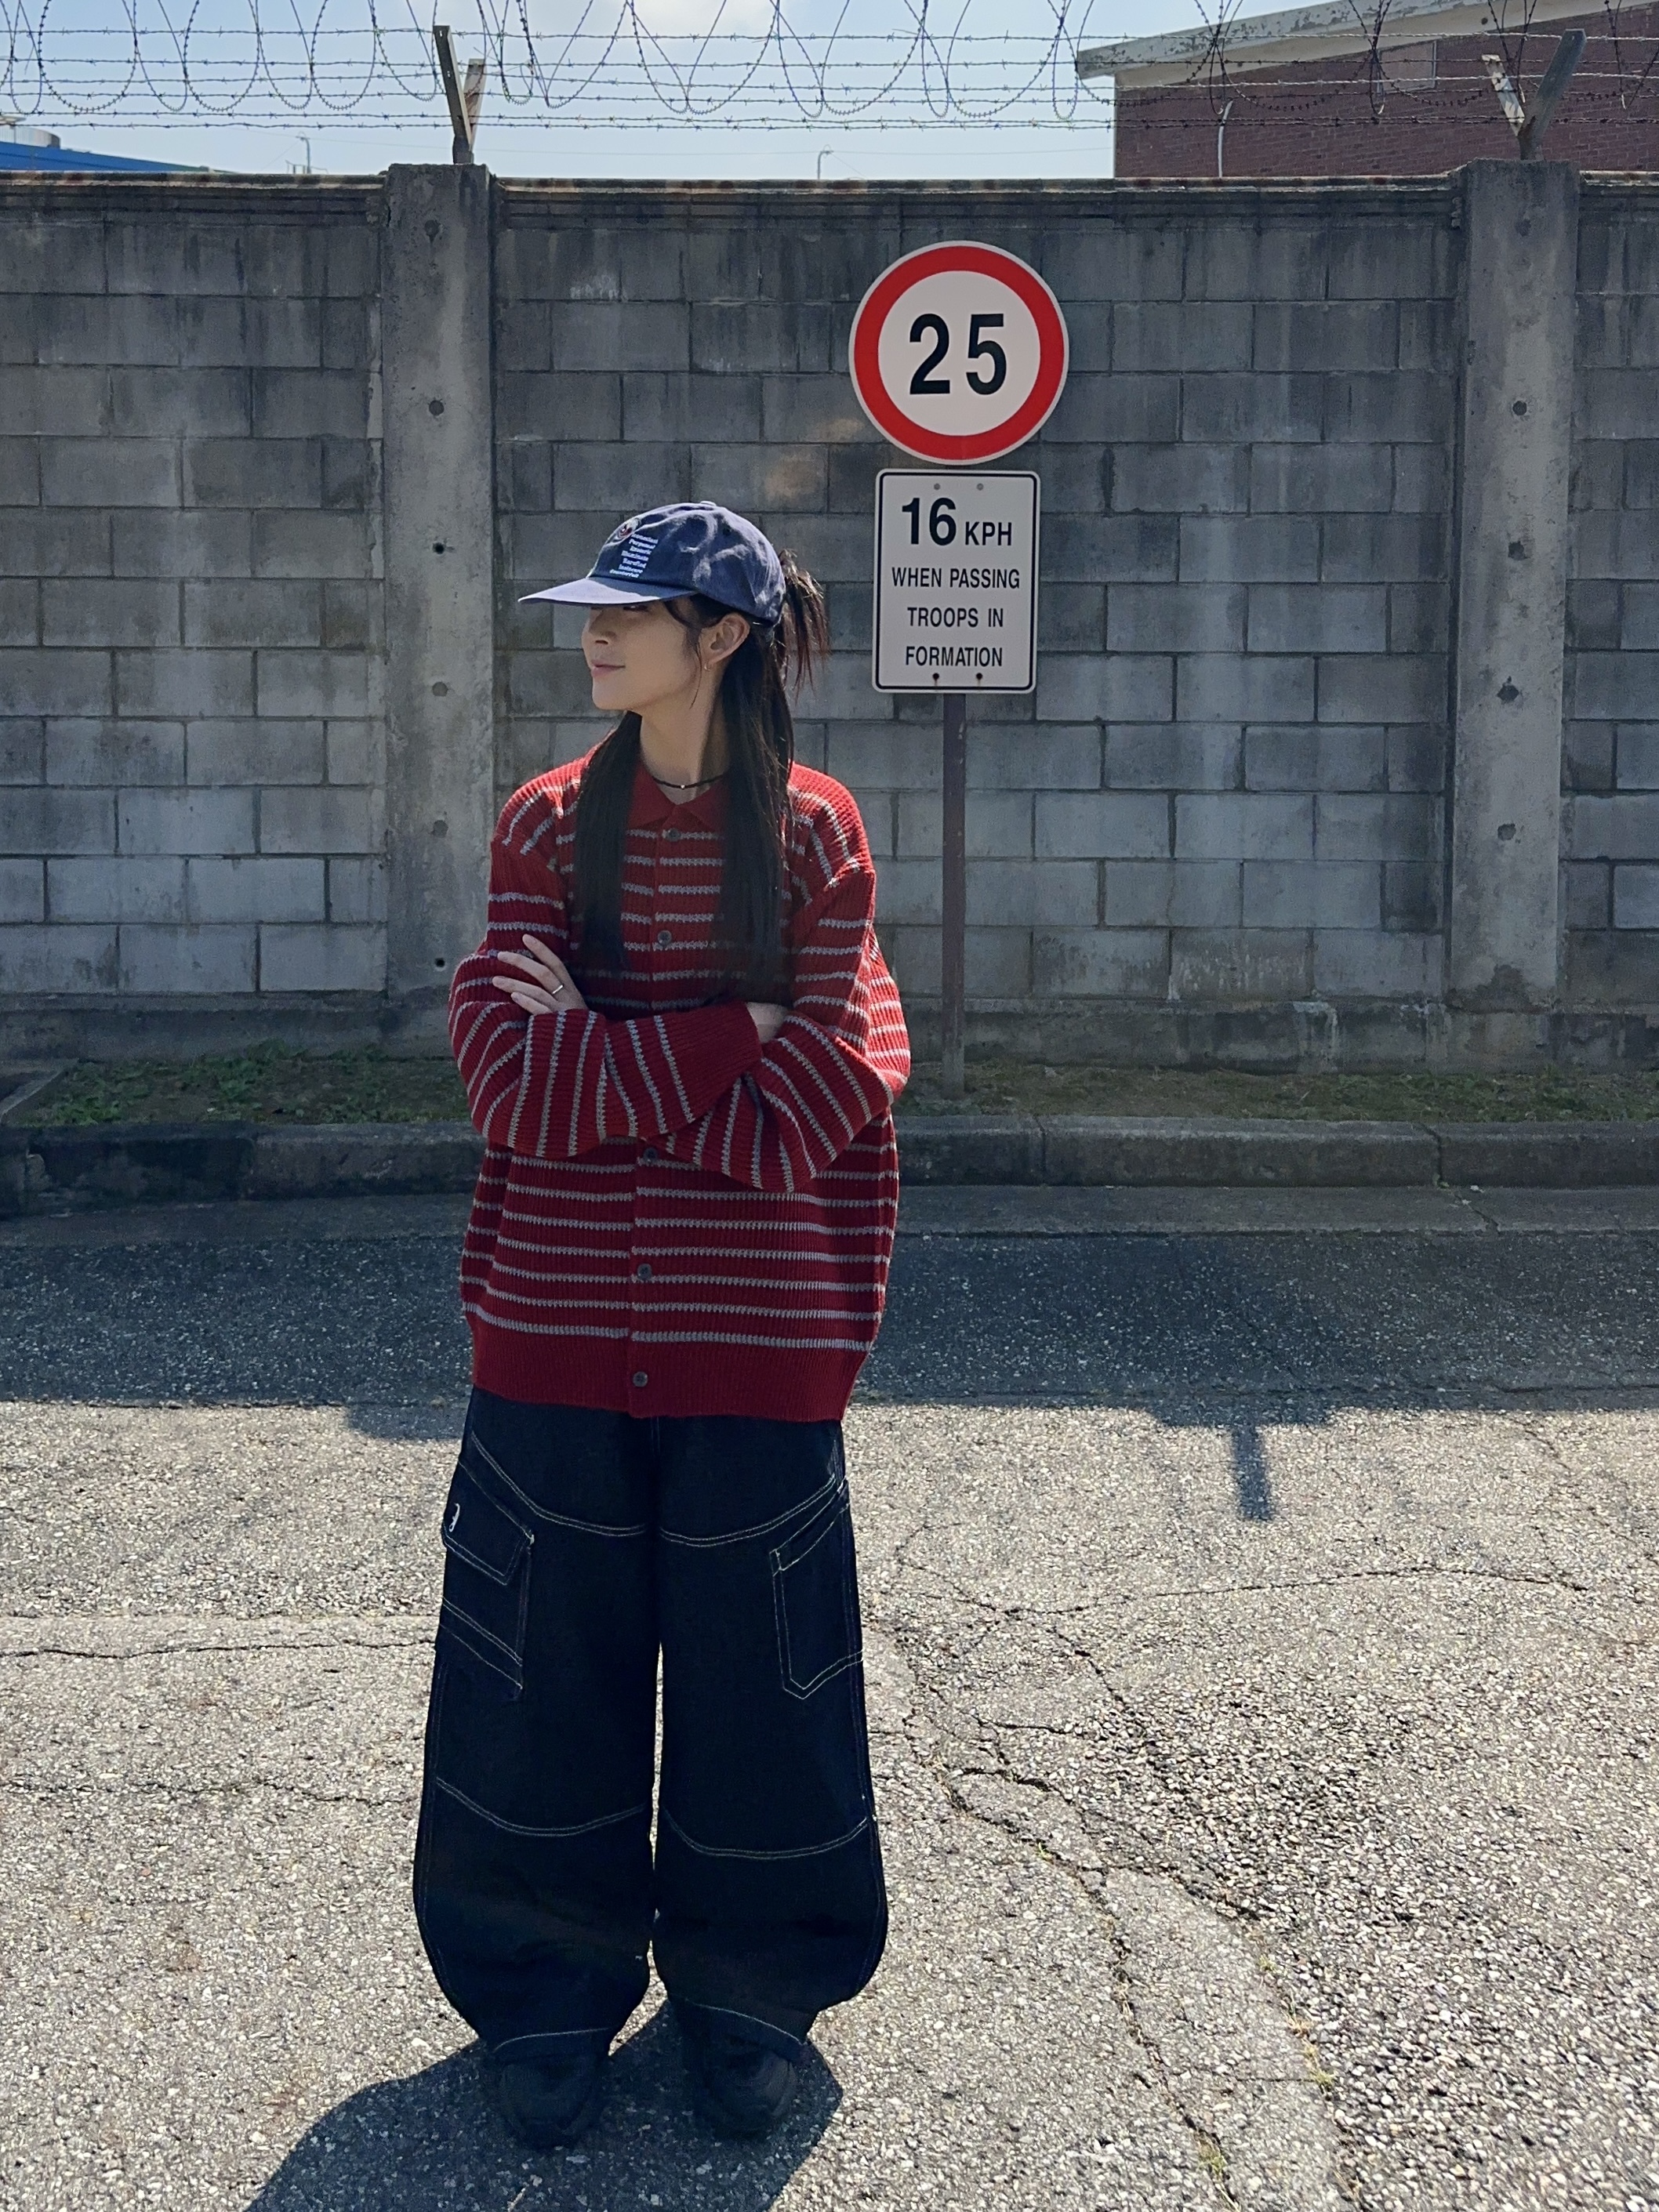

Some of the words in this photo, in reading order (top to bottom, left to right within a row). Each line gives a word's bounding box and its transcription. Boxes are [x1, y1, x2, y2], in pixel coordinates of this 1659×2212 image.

[909, 313, 1007, 395] 25
[902, 497, 957, 546] 16
[964, 520, 1012, 546] KPH
[891, 567, 942, 588] WHEN
[949, 568, 1020, 589] PASSING
[907, 607, 978, 628] TROOPS
[988, 607, 1004, 628] IN
[905, 645, 1003, 668] FORMATION
